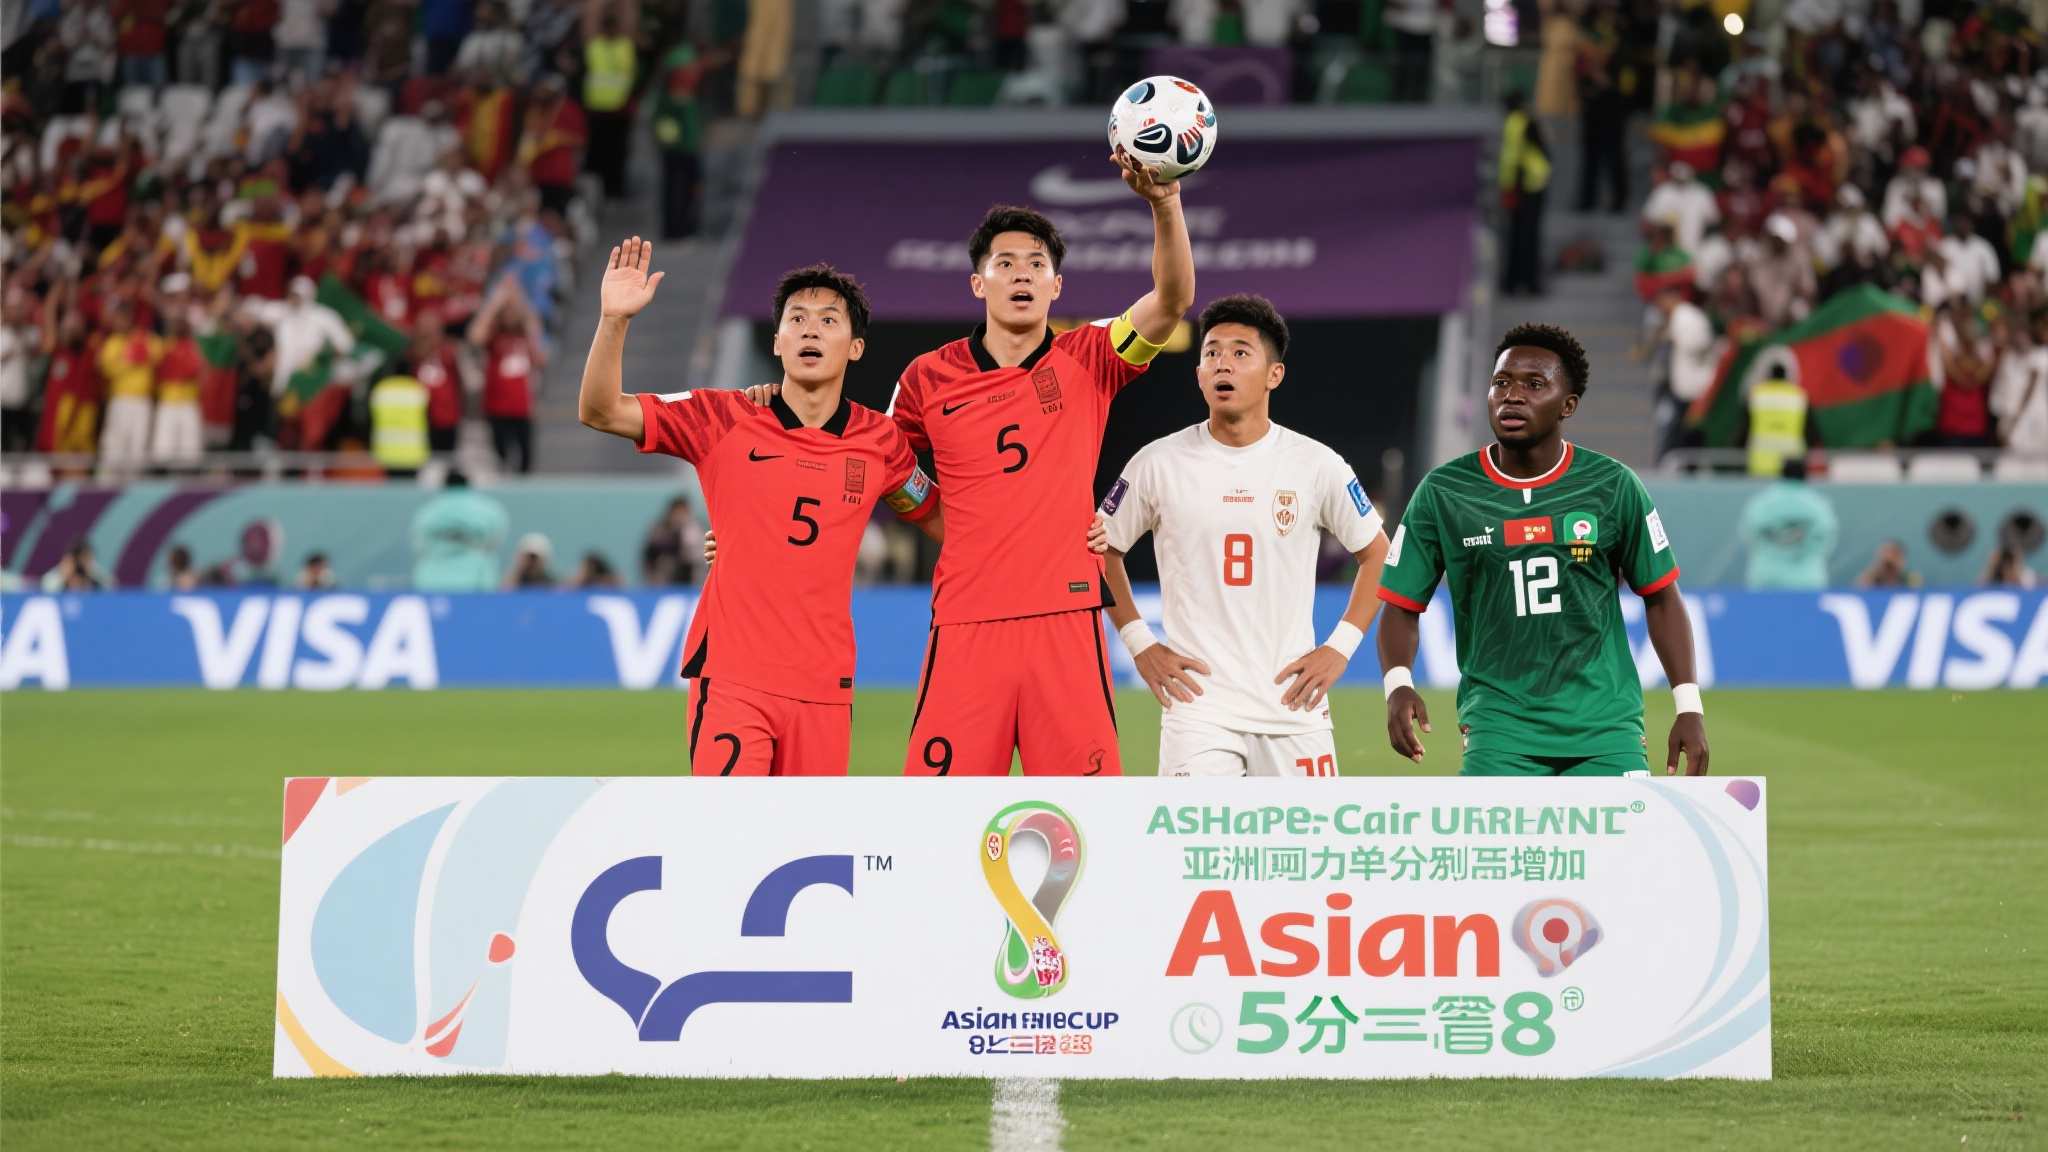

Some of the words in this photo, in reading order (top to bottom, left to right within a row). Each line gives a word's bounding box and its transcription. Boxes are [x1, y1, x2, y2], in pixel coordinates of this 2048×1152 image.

[996, 424, 1028, 473] 5
[788, 496, 821, 547] 5
[1223, 532, 1254, 587] 8
[1508, 556, 1562, 617] 12
[173, 595, 439, 691] VISA
[923, 736, 953, 776] 9
[863, 855, 892, 871] TM
[1165, 889, 1501, 978] Asian
